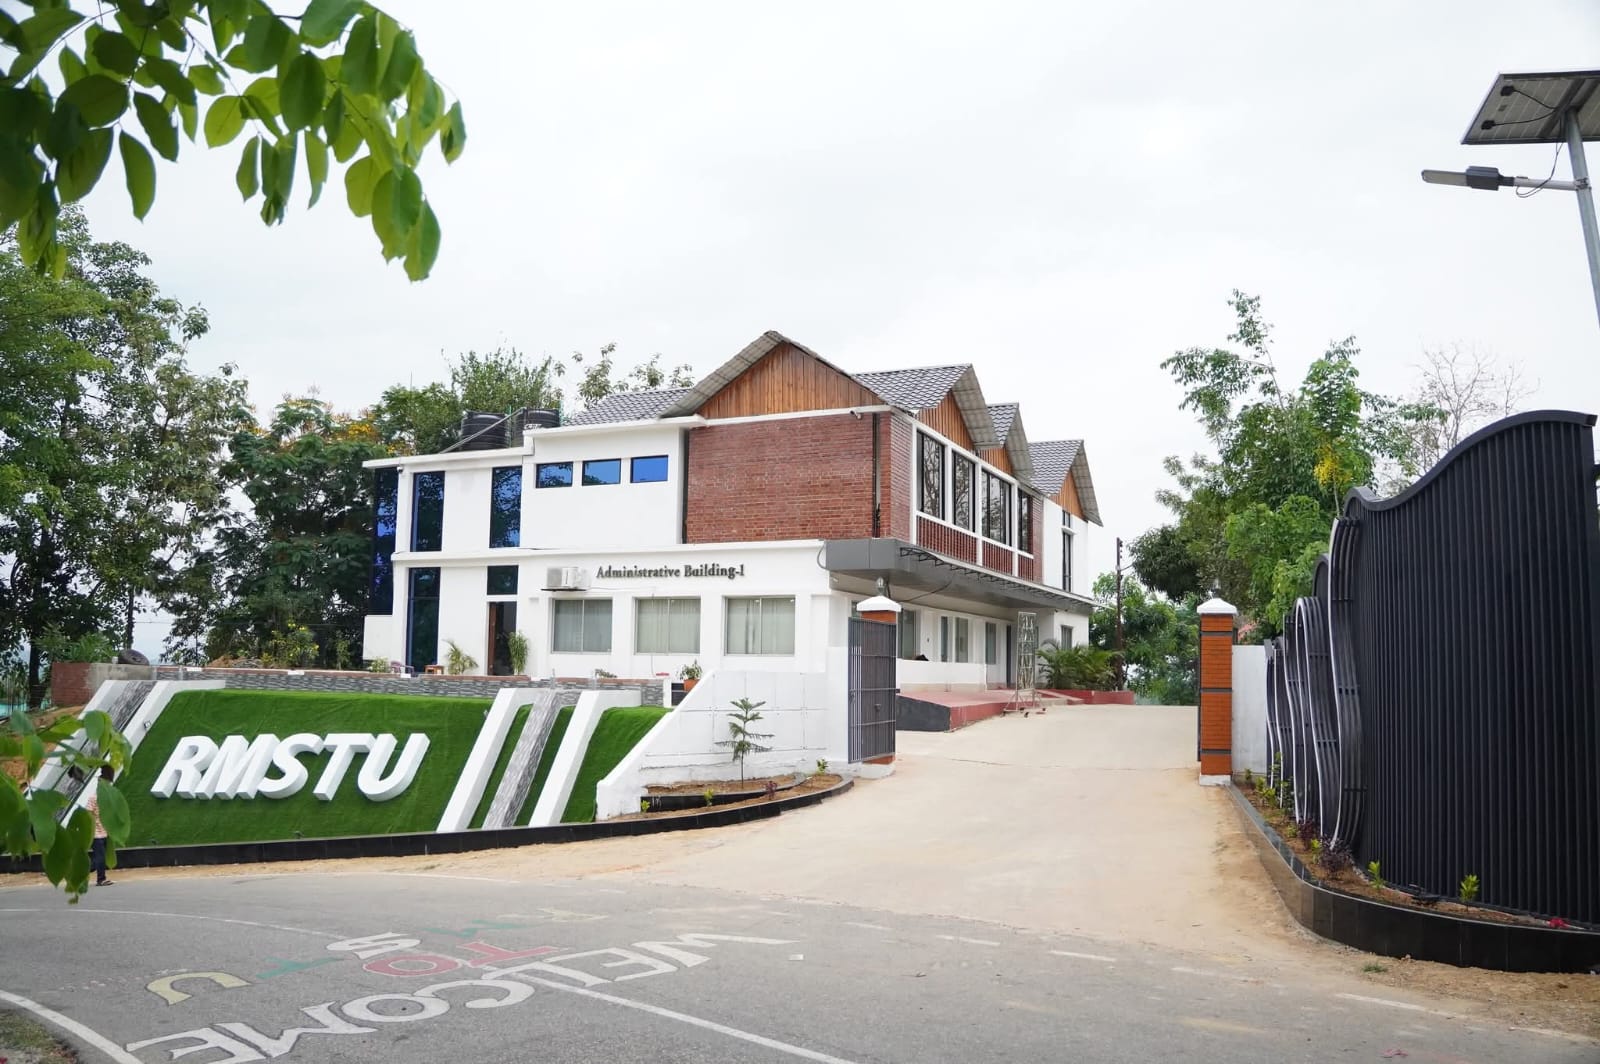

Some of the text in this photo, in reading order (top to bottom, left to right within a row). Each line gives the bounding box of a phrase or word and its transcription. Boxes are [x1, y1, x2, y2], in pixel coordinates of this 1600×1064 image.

[596, 563, 744, 580] Administrative Building-1
[150, 733, 431, 801] RMSTU
[362, 938, 568, 977] TO
[125, 933, 801, 1064] WELCOME
